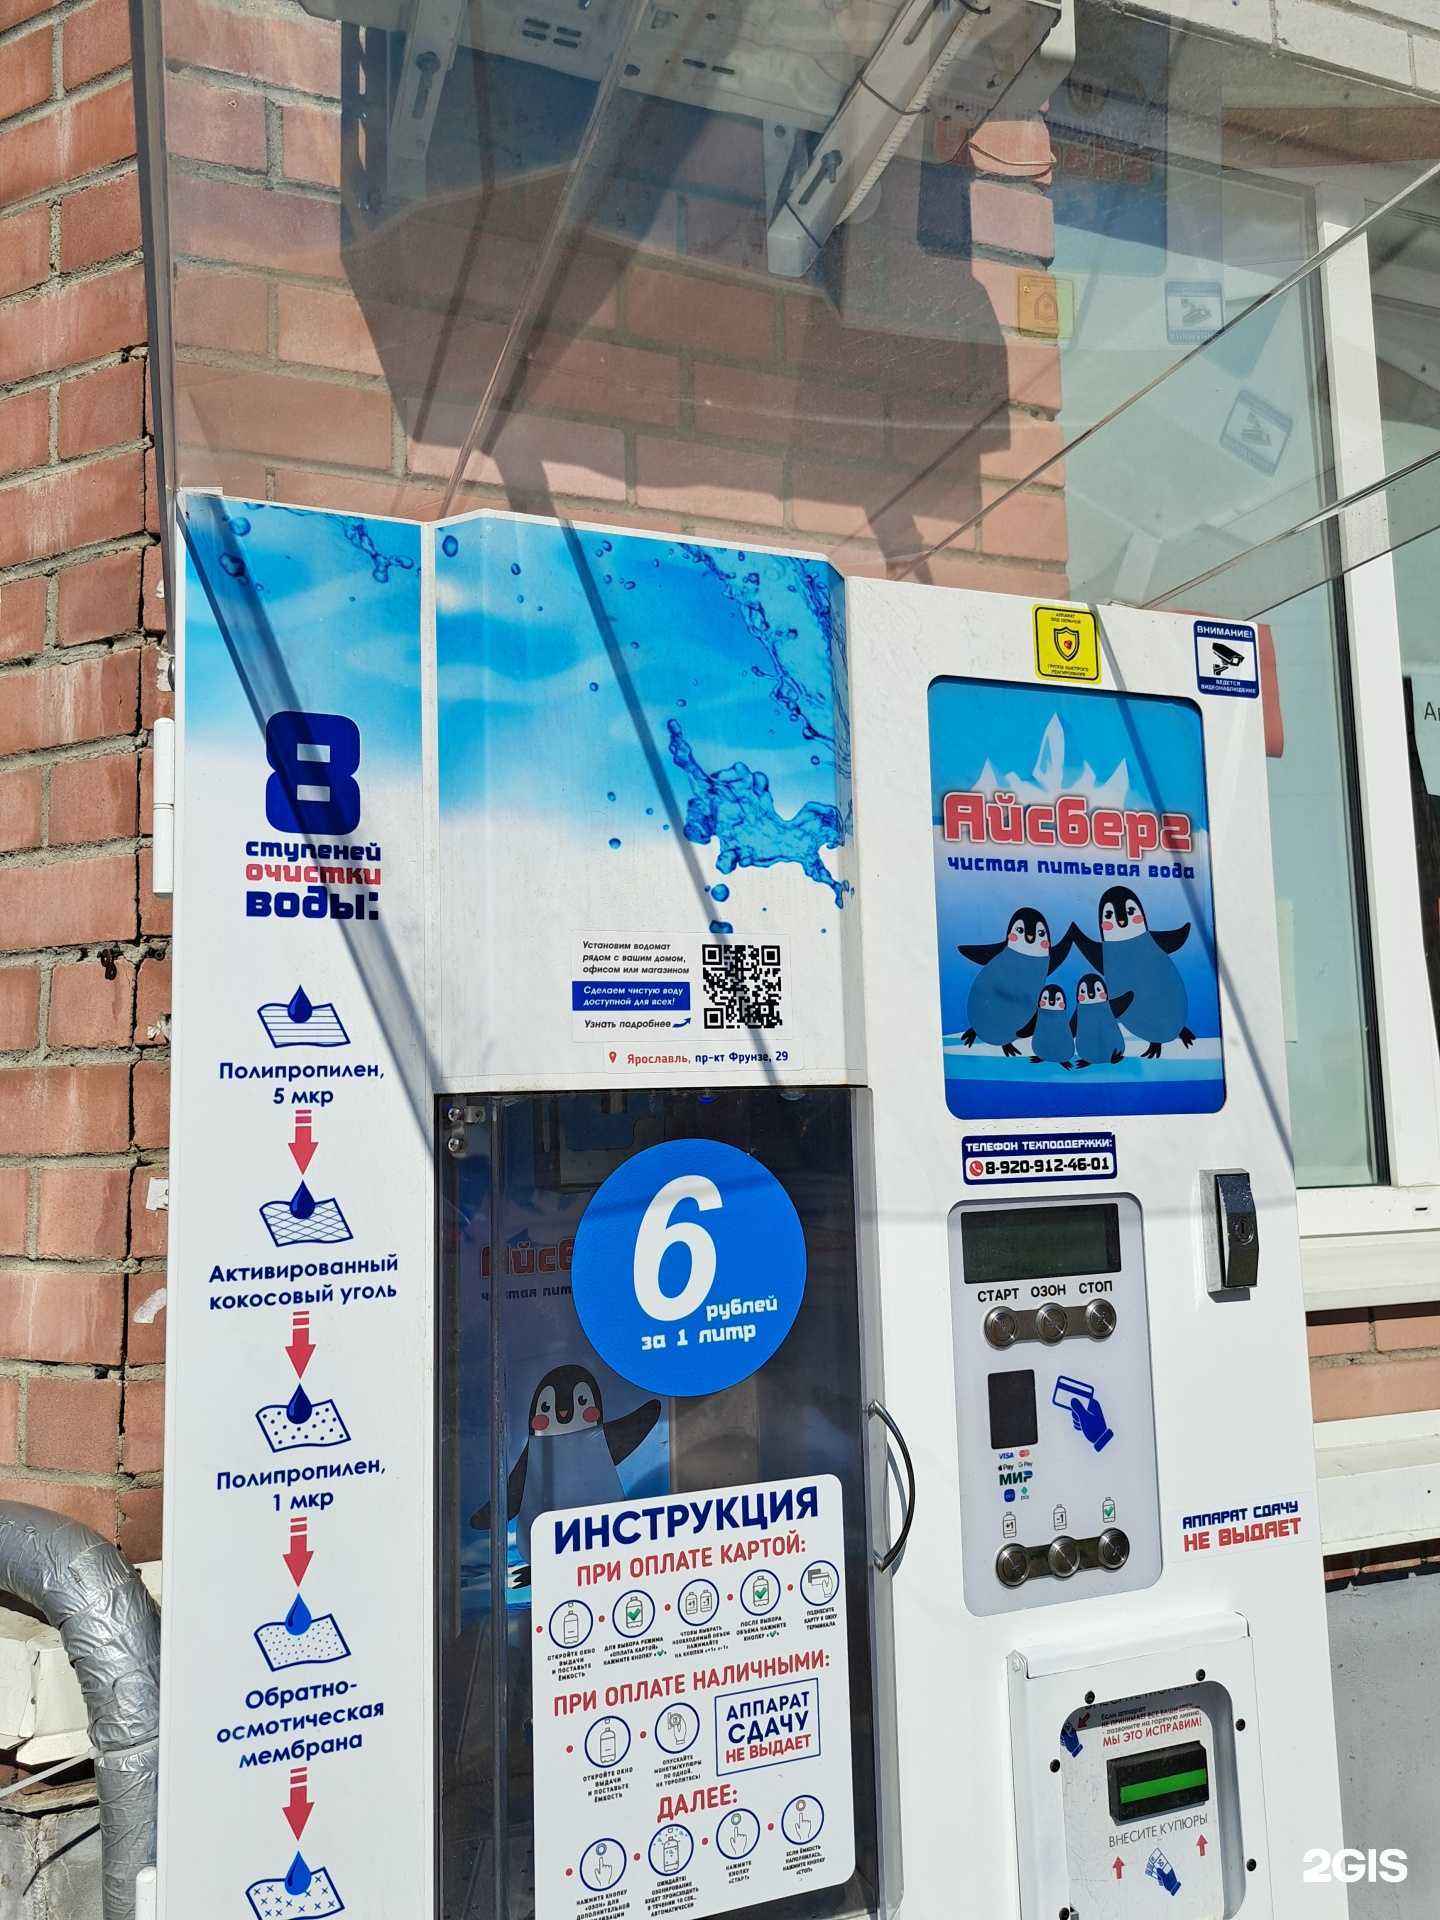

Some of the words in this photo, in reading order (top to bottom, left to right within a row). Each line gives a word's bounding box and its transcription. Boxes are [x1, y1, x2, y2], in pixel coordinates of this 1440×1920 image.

[1197, 626, 1252, 638] ВНИМАНИЕ!
[266, 710, 360, 836] 8
[943, 792, 1192, 860] Айсберг
[246, 841, 381, 862] ступеней
[246, 864, 382, 885] очистки
[948, 856, 1028, 873] чистая
[1037, 858, 1140, 878] питьевая
[1148, 862, 1194, 880] вода
[246, 885, 379, 920] воды:
[582, 940, 631, 950] Установим
[633, 943, 671, 951] водомат
[582, 954, 613, 964] рядом
[655, 955, 686, 964] домом,
[582, 966, 621, 976] офисом
[641, 967, 690, 975] магазином
[584, 986, 625, 996] Сделаем
[628, 987, 661, 996] чистую
[663, 988, 684, 996] воду
[584, 997, 631, 1008] доступной
[634, 998, 650, 1007] для
[652, 998, 676, 1006] всех!
[584, 1020, 616, 1029] Узнать
[620, 1018, 671, 1030] подробнее
[219, 1062, 384, 1082] Полипропилен,
[628, 1054, 691, 1066] Ярославль,
[695, 1054, 724, 1065] пр-кт
[729, 1052, 772, 1064] Фрунзе,
[776, 1051, 789, 1062] 29
[273, 1088, 284, 1104] 5
[292, 1089, 334, 1107] мкр
[965, 1142, 1018, 1152] ТЕЛЕФОН
[1022, 1138, 1113, 1150] ТЕХПОДДЕРЖКИ:
[985, 1157, 1110, 1175] 8-920-912-46-01
[633, 1174, 723, 1322] 6
[208, 1254, 398, 1283] Активированный
[209, 1284, 334, 1310] кокосовый
[340, 1284, 398, 1304] уголь
[977, 1287, 1020, 1302] СТАРТ
[1030, 1284, 1066, 1298] ОЗОН
[1078, 1280, 1113, 1294] СТОП
[706, 1294, 778, 1322] рублей
[641, 1334, 666, 1351] за
[677, 1328, 688, 1346] 1
[699, 1323, 756, 1343] литр
[217, 1459, 386, 1490] Полипропилен,
[999, 1470, 1033, 1486] МИР
[273, 1494, 280, 1511] 1
[290, 1491, 334, 1510] мкр
[1182, 1508, 1248, 1530] АППАРАТ
[1253, 1500, 1299, 1518] СДАЧУ
[555, 1486, 818, 1554] ИНСТРУКЦИЯ
[1184, 1531, 1210, 1552] НЕ
[1218, 1518, 1301, 1546] ВЫДАЕТ
[577, 1559, 620, 1587] ПРИ
[630, 1547, 713, 1578] ОПЛАТЕ
[720, 1530, 806, 1564] КАРТОЙ:
[245, 1680, 358, 1710] Обратно-
[554, 1690, 597, 1716] ПРИ
[605, 1674, 685, 1706] ОПЛАТЕ
[693, 1649, 830, 1691] НАЛИЧНЫМИ:
[726, 1691, 810, 1722] АППАРАТ
[216, 1702, 384, 1744] осмотическая
[728, 1710, 808, 1744] СДАЧУ
[1103, 1735, 1120, 1748] МЫ
[1124, 1730, 1142, 1742] ЭТО
[1146, 1718, 1202, 1737] ИСПРАВИМ!
[239, 1733, 363, 1768] мембрана
[726, 1747, 745, 1764] НЕ
[749, 1734, 812, 1758] ВЫДАЕТ
[582, 1770, 614, 1782] ОТКРОЙТЕ
[656, 1784, 738, 1822] ДАЛЕЕ:
[1108, 1824, 1158, 1848] ВНЕСИТЕ
[1160, 1814, 1208, 1836] КУПЮРЫ
